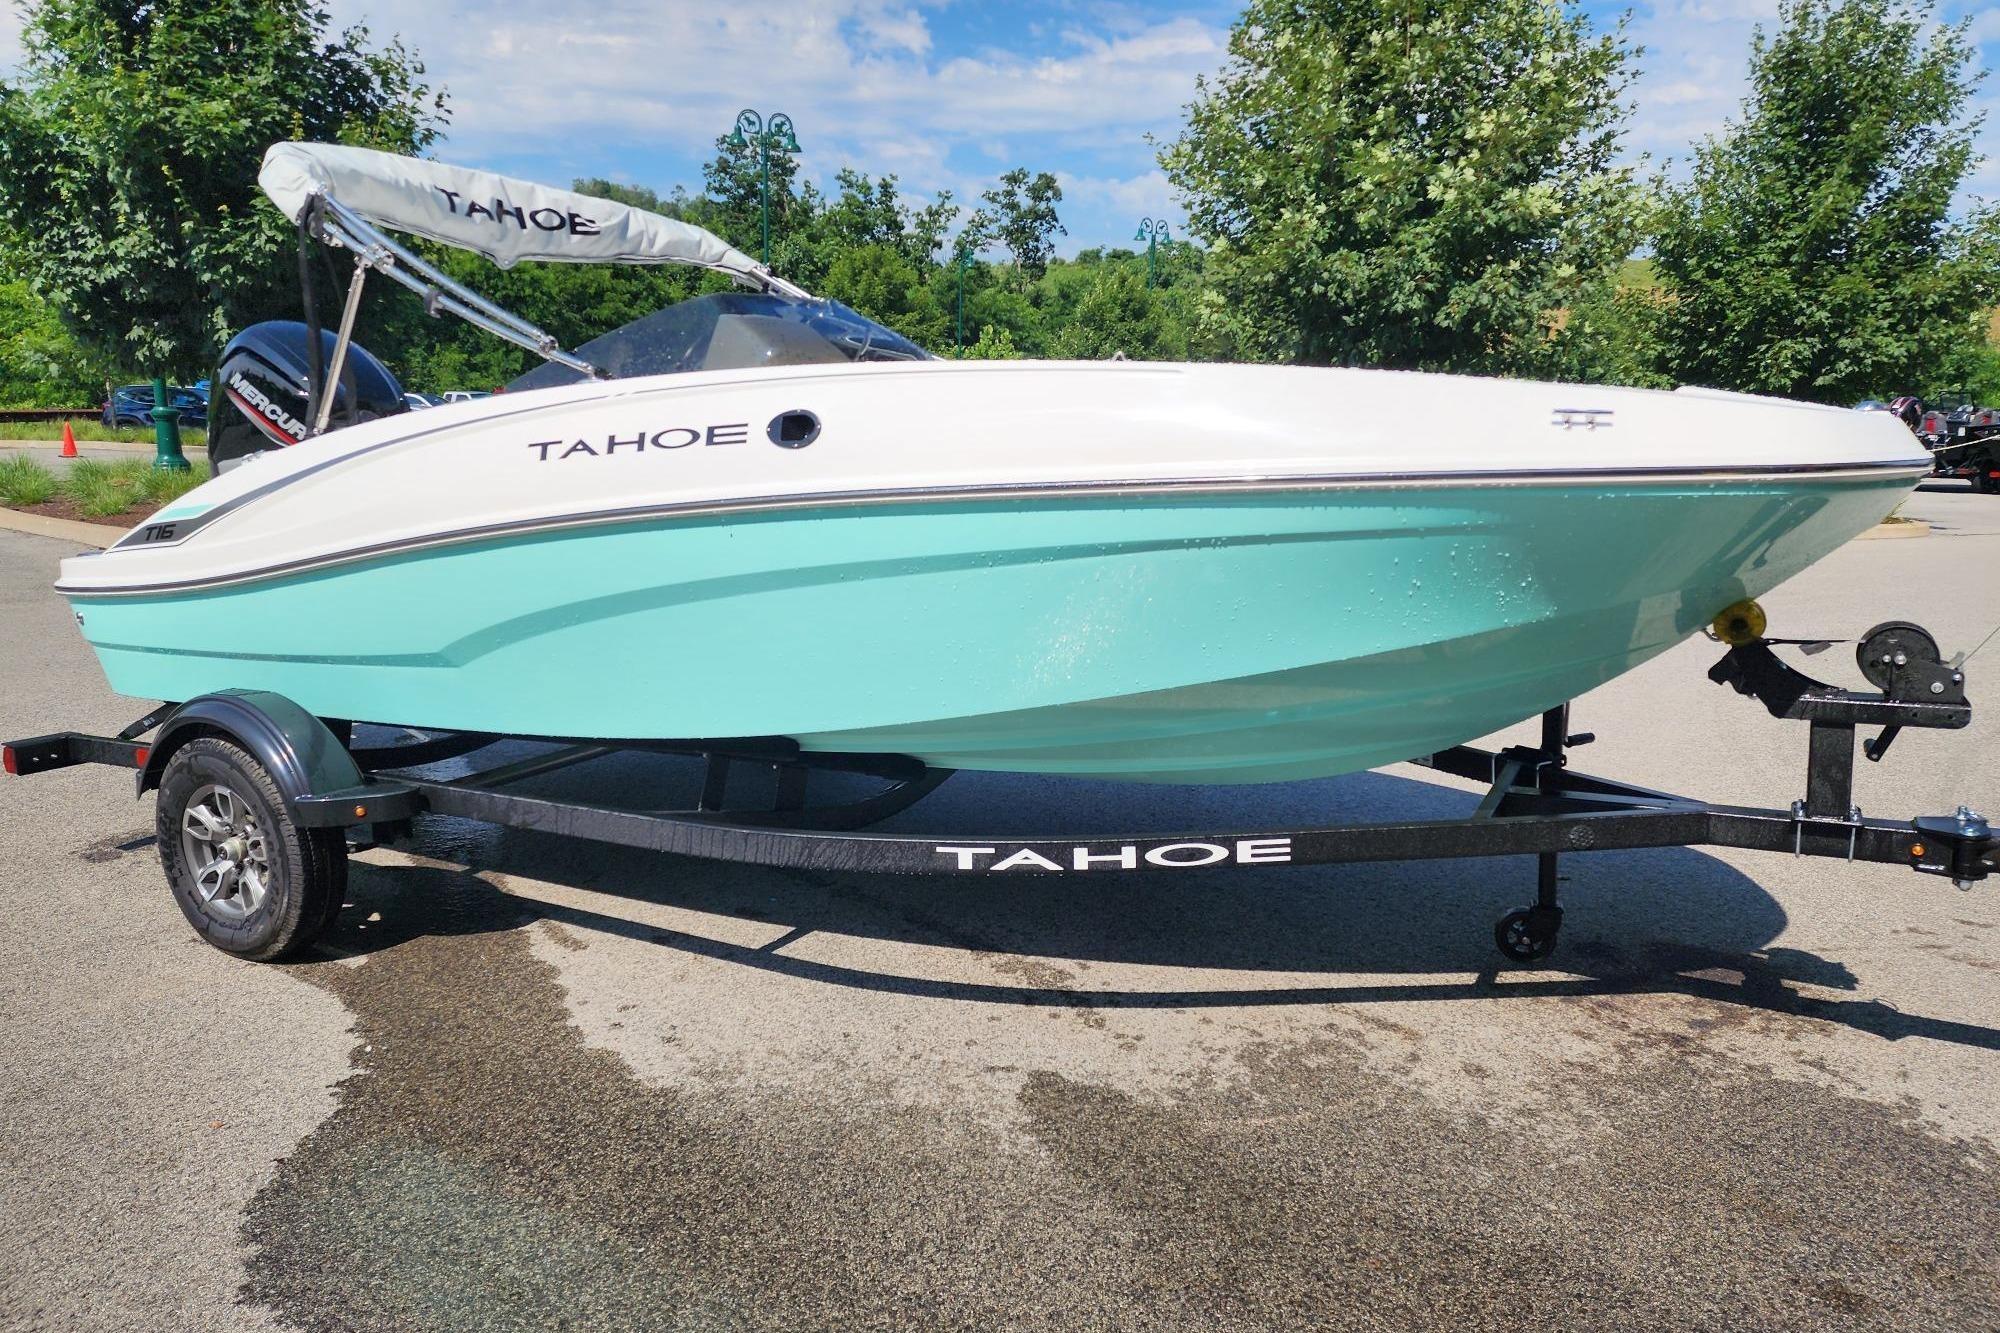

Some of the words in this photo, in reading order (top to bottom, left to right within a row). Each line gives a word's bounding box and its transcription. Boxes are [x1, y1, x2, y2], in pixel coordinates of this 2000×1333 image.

[433, 184, 601, 236] TAHOE
[229, 371, 307, 441] MERCUR
[528, 423, 749, 461] TAHOE
[145, 523, 177, 541] T16
[935, 838, 1292, 871] TAHOE
